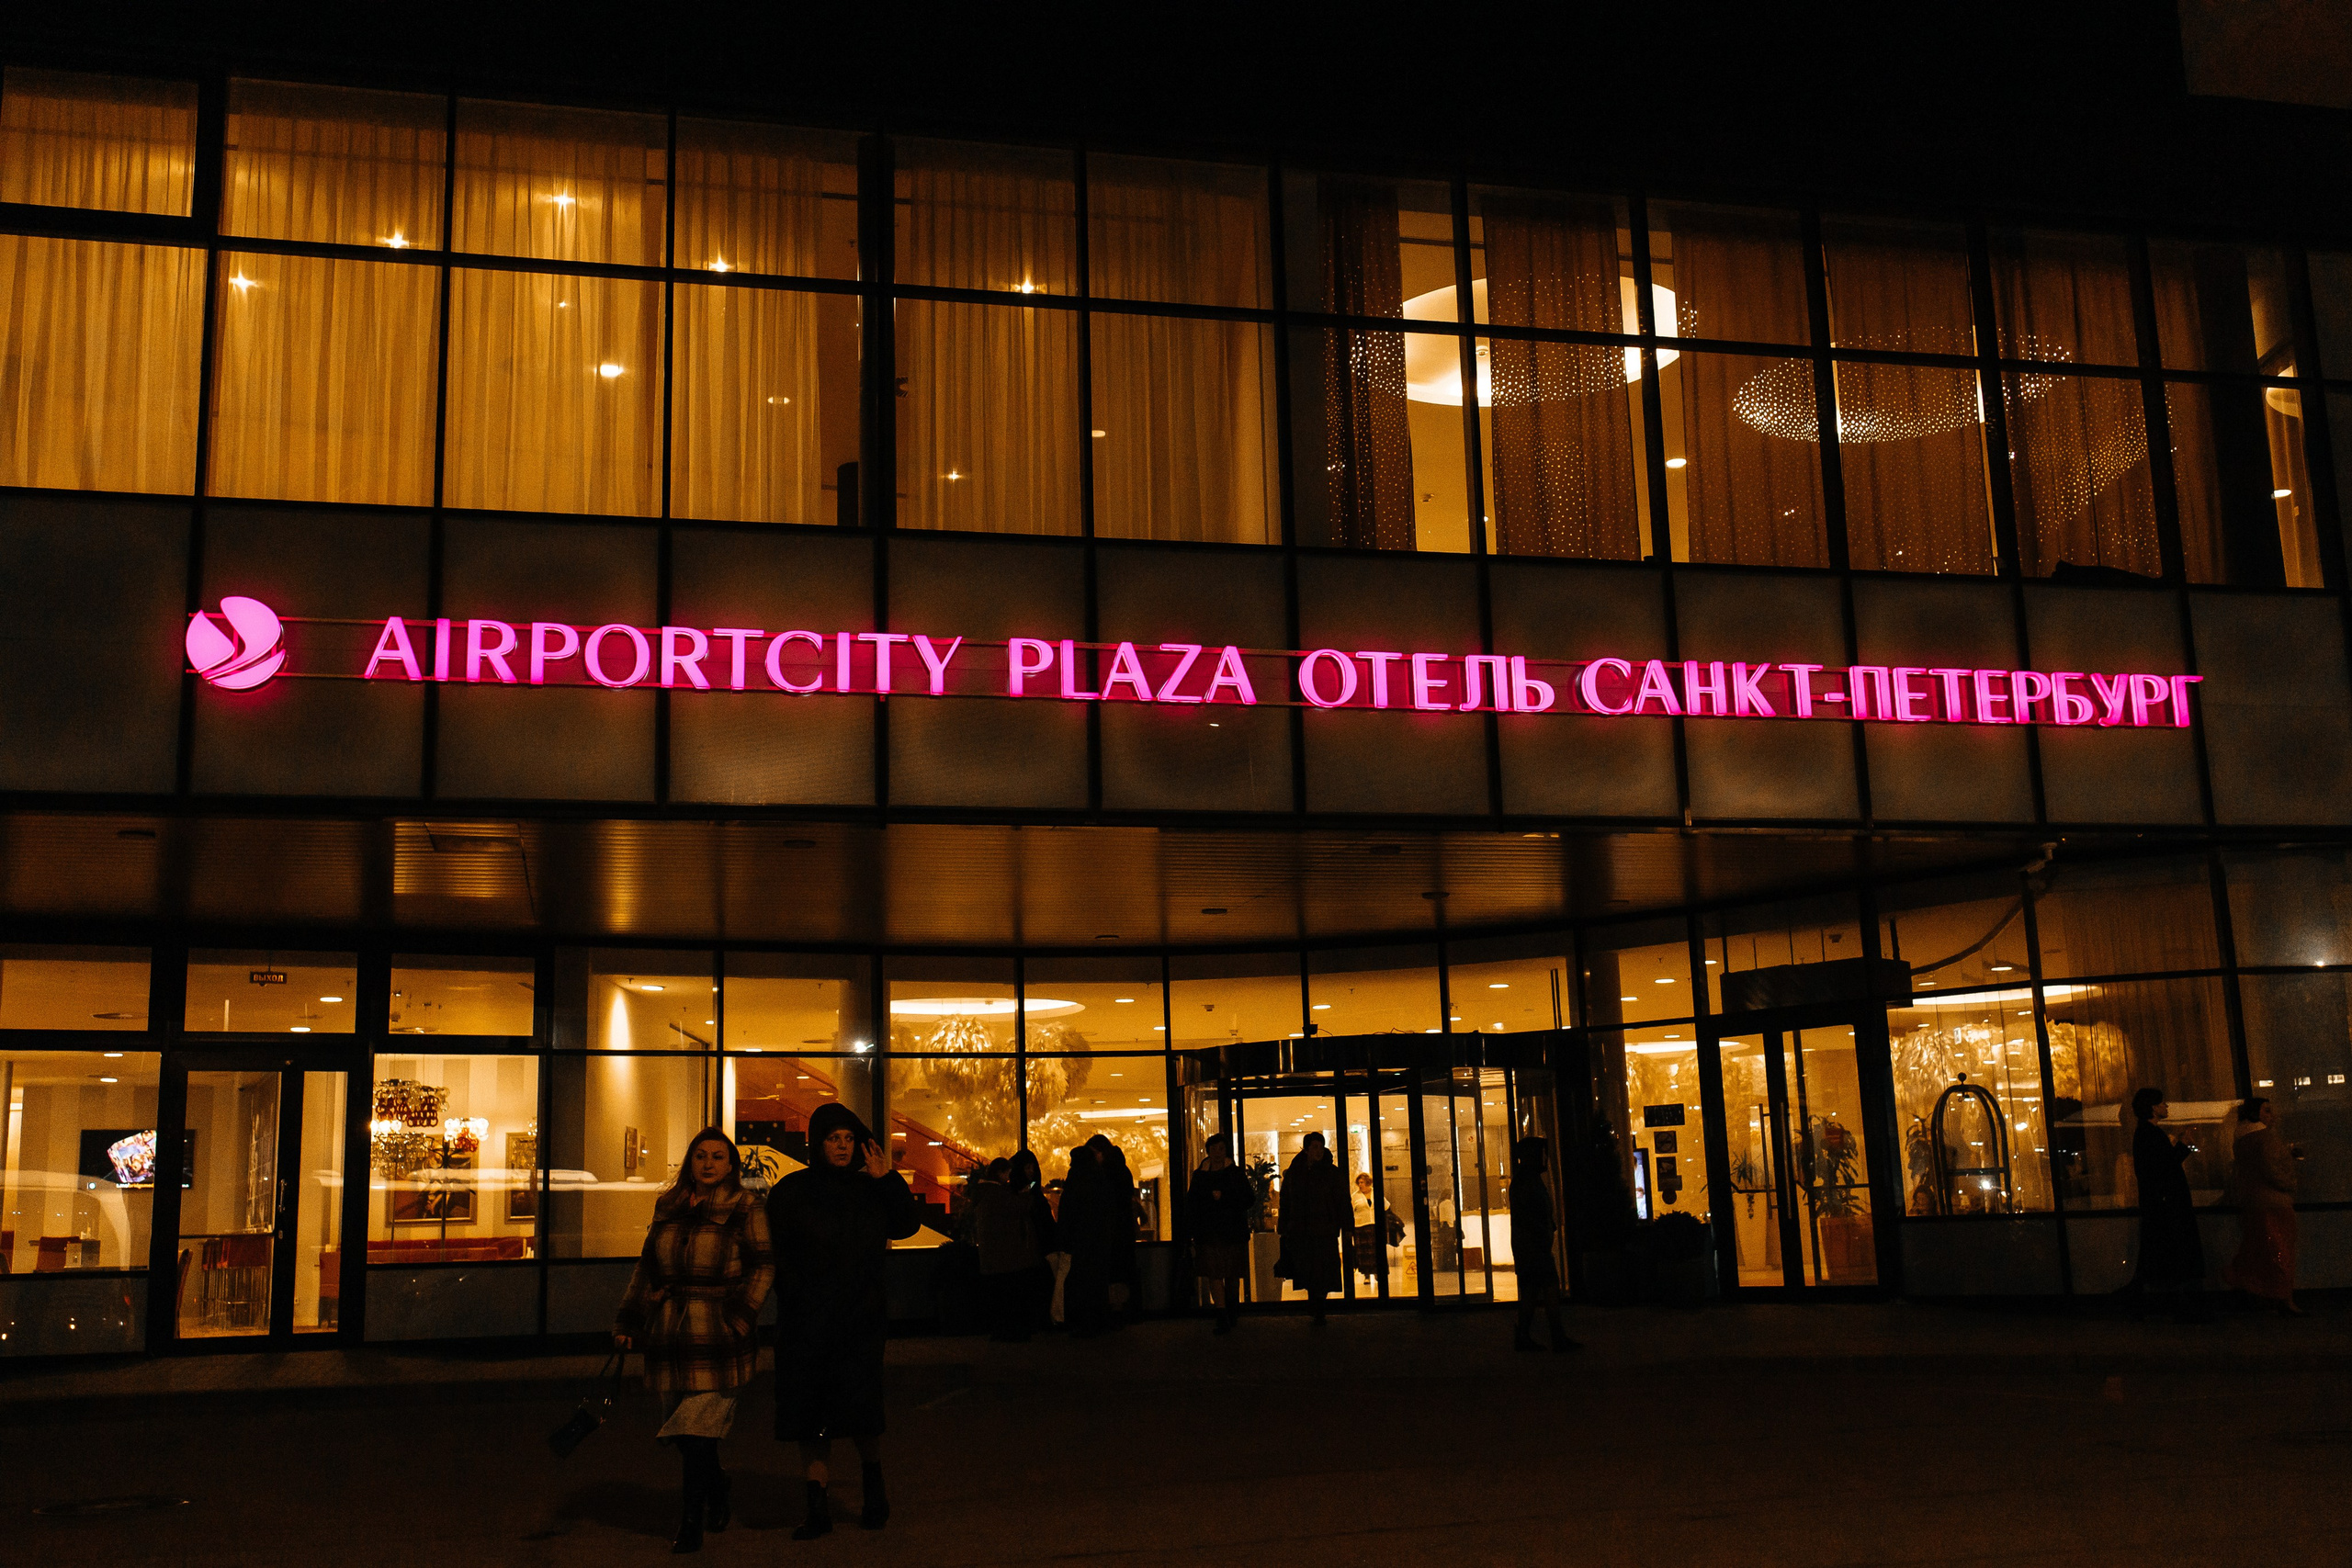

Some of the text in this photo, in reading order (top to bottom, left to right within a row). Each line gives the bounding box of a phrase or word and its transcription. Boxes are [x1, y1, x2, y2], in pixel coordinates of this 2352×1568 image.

[364, 615, 2204, 728] AIRPORTCITY PLAZA ОТЕЛЬ САНКТ-ПЕТЕРБУРГ
[253, 974, 284, 983] ВЫХОД
